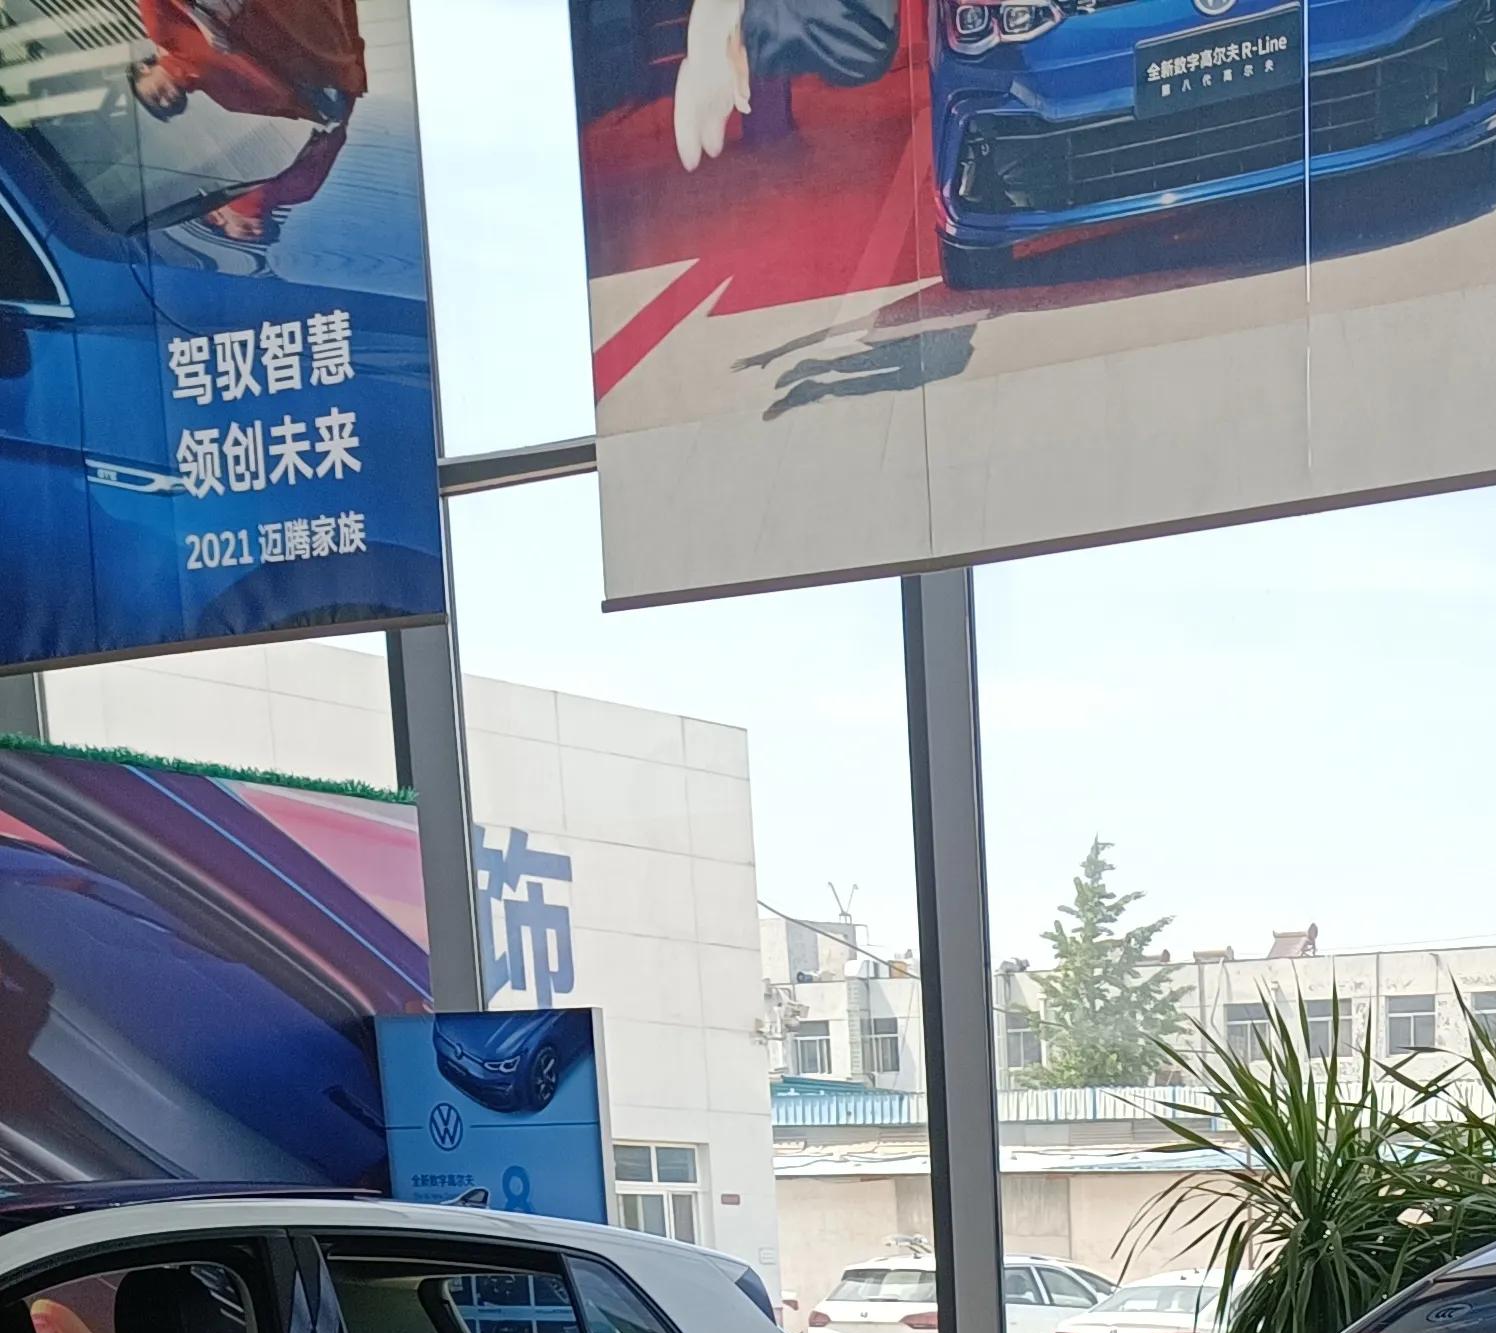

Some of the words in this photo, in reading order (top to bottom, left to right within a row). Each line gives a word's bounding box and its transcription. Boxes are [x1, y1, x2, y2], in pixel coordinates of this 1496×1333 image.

[1146, 43, 1240, 82] 全新数字高尔夫
[1241, 35, 1288, 60] R-Line
[167, 309, 356, 407] 驾驭智慧
[176, 406, 363, 500] 领创未来
[185, 530, 254, 571] 2021
[257, 510, 367, 566] 迈腾家族
